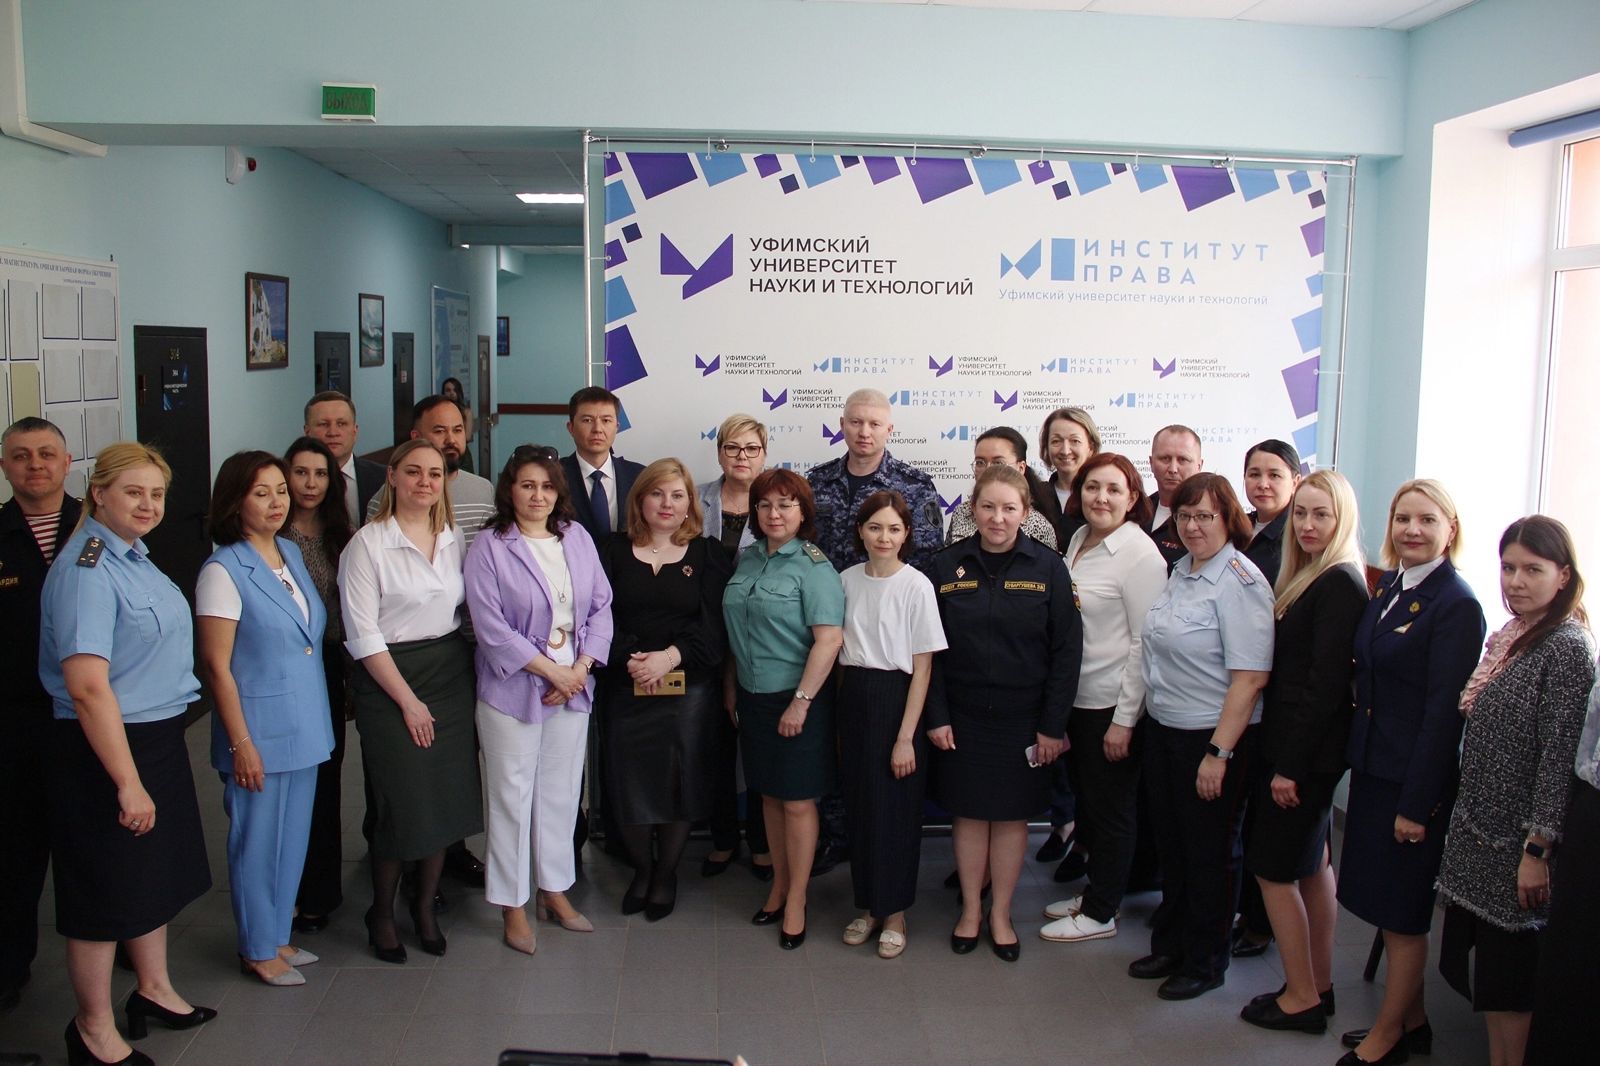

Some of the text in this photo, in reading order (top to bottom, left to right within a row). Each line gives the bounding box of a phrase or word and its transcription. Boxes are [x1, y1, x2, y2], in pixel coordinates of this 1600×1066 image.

[327, 92, 368, 111] ВЫХОД
[749, 235, 869, 253] УФИМСКИЙ
[1084, 239, 1269, 261] ИНСТИТУТ
[749, 258, 897, 274] УНИВЕРСИТЕТ
[1084, 265, 1195, 284] ПРАВА
[749, 278, 974, 295] НАУКИ И ТЕХНОЛОГИЙ
[999, 289, 1268, 306] Уфимский университет науки и технологий
[844, 357, 914, 365] ИНСТИТУТ
[1180, 357, 1218, 365] УФИМСКИЙ
[756, 368, 802, 376] ТЕХНОЛОГИЙ
[844, 366, 887, 374] ПРАВА
[988, 369, 1032, 377] ТЕХНОЛОГИЙ
[1070, 366, 1111, 374] ПРАВА
[912, 390, 982, 398] ИНСТИТУТ
[1023, 389, 1062, 397] УФИМСКИЙ
